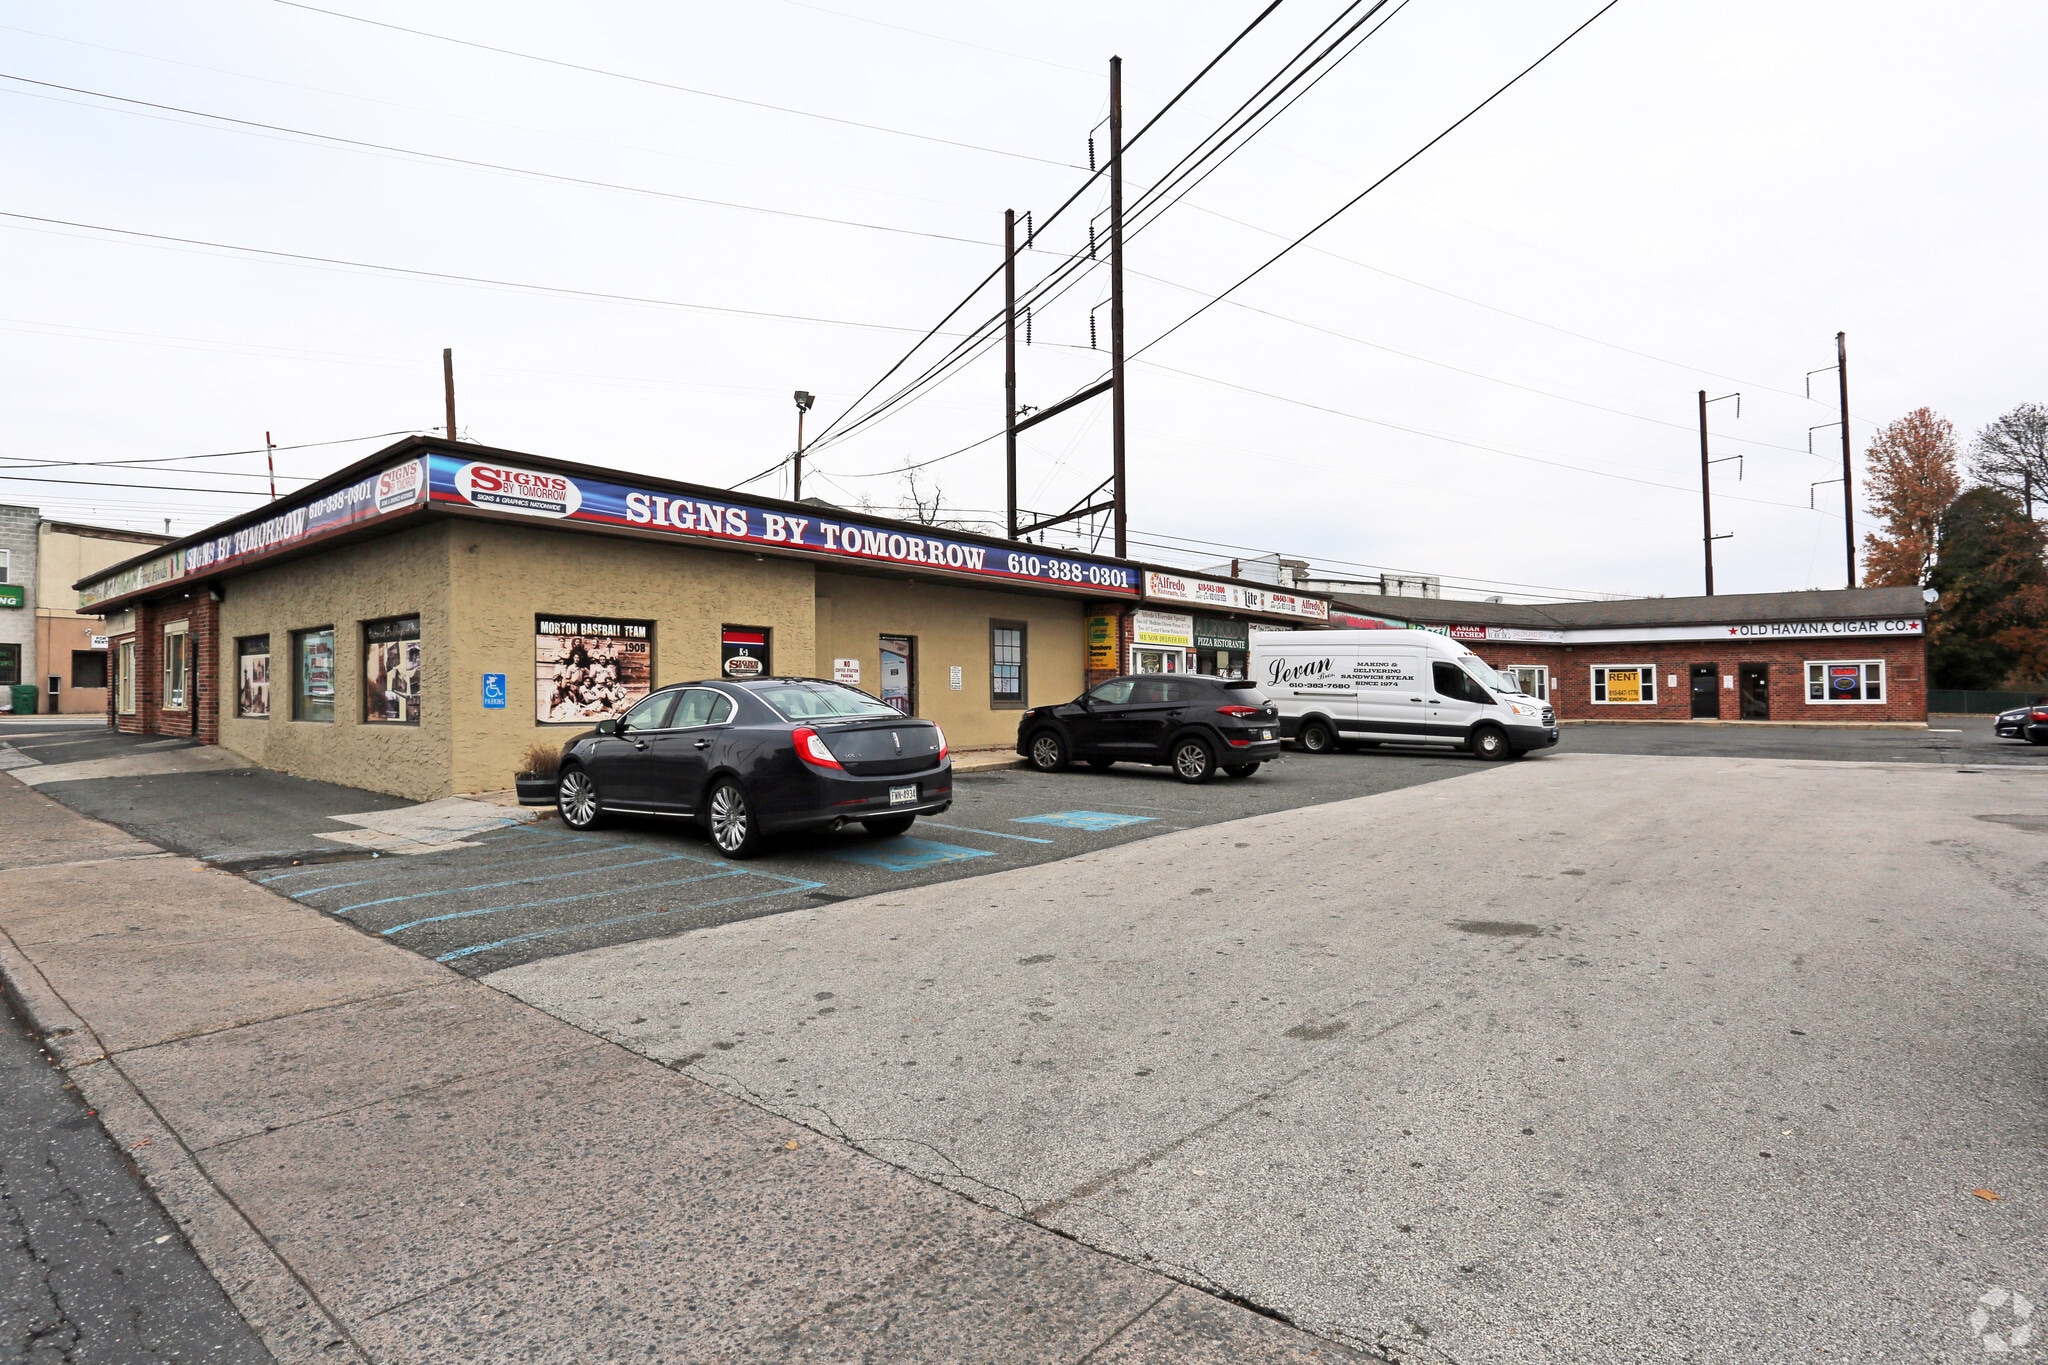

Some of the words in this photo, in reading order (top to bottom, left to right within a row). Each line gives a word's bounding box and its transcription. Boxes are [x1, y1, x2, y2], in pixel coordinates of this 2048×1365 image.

[380, 462, 417, 496] SIGNS
[471, 466, 566, 491] SIGNS
[308, 481, 371, 519] 610-338-0301
[503, 482, 514, 493] BY
[518, 484, 566, 500] TOMORROW
[476, 494, 495, 502] SIGNS
[502, 498, 528, 506] GRAPHICS
[530, 502, 561, 511] NATIONWIDE
[186, 542, 215, 570] SIGNS
[218, 535, 232, 560] BY
[234, 507, 307, 555] TOMORROW
[626, 492, 748, 537] SIGNS
[762, 513, 809, 544] BY
[820, 522, 986, 570] TOMORROW
[1008, 554, 1128, 588] 610-338-0301
[1158, 576, 1185, 592] Alfredo
[1244, 591, 1257, 608] Lite
[1302, 599, 1320, 610] Alfredo
[540, 621, 577, 635] MORTON
[581, 623, 620, 637] BASEBALL
[624, 625, 646, 638] TEAM
[1740, 624, 1768, 636] OLD
[1772, 622, 1829, 634] HAVANA
[1832, 621, 1878, 633] CIGAR
[1884, 620, 1908, 631] CO.
[624, 643, 646, 652] 1908
[1198, 637, 1212, 646] PIZZA
[1214, 638, 1245, 649] RISTORANTE
[1268, 658, 1336, 686] Levan
[1609, 673, 1638, 681] RENT
